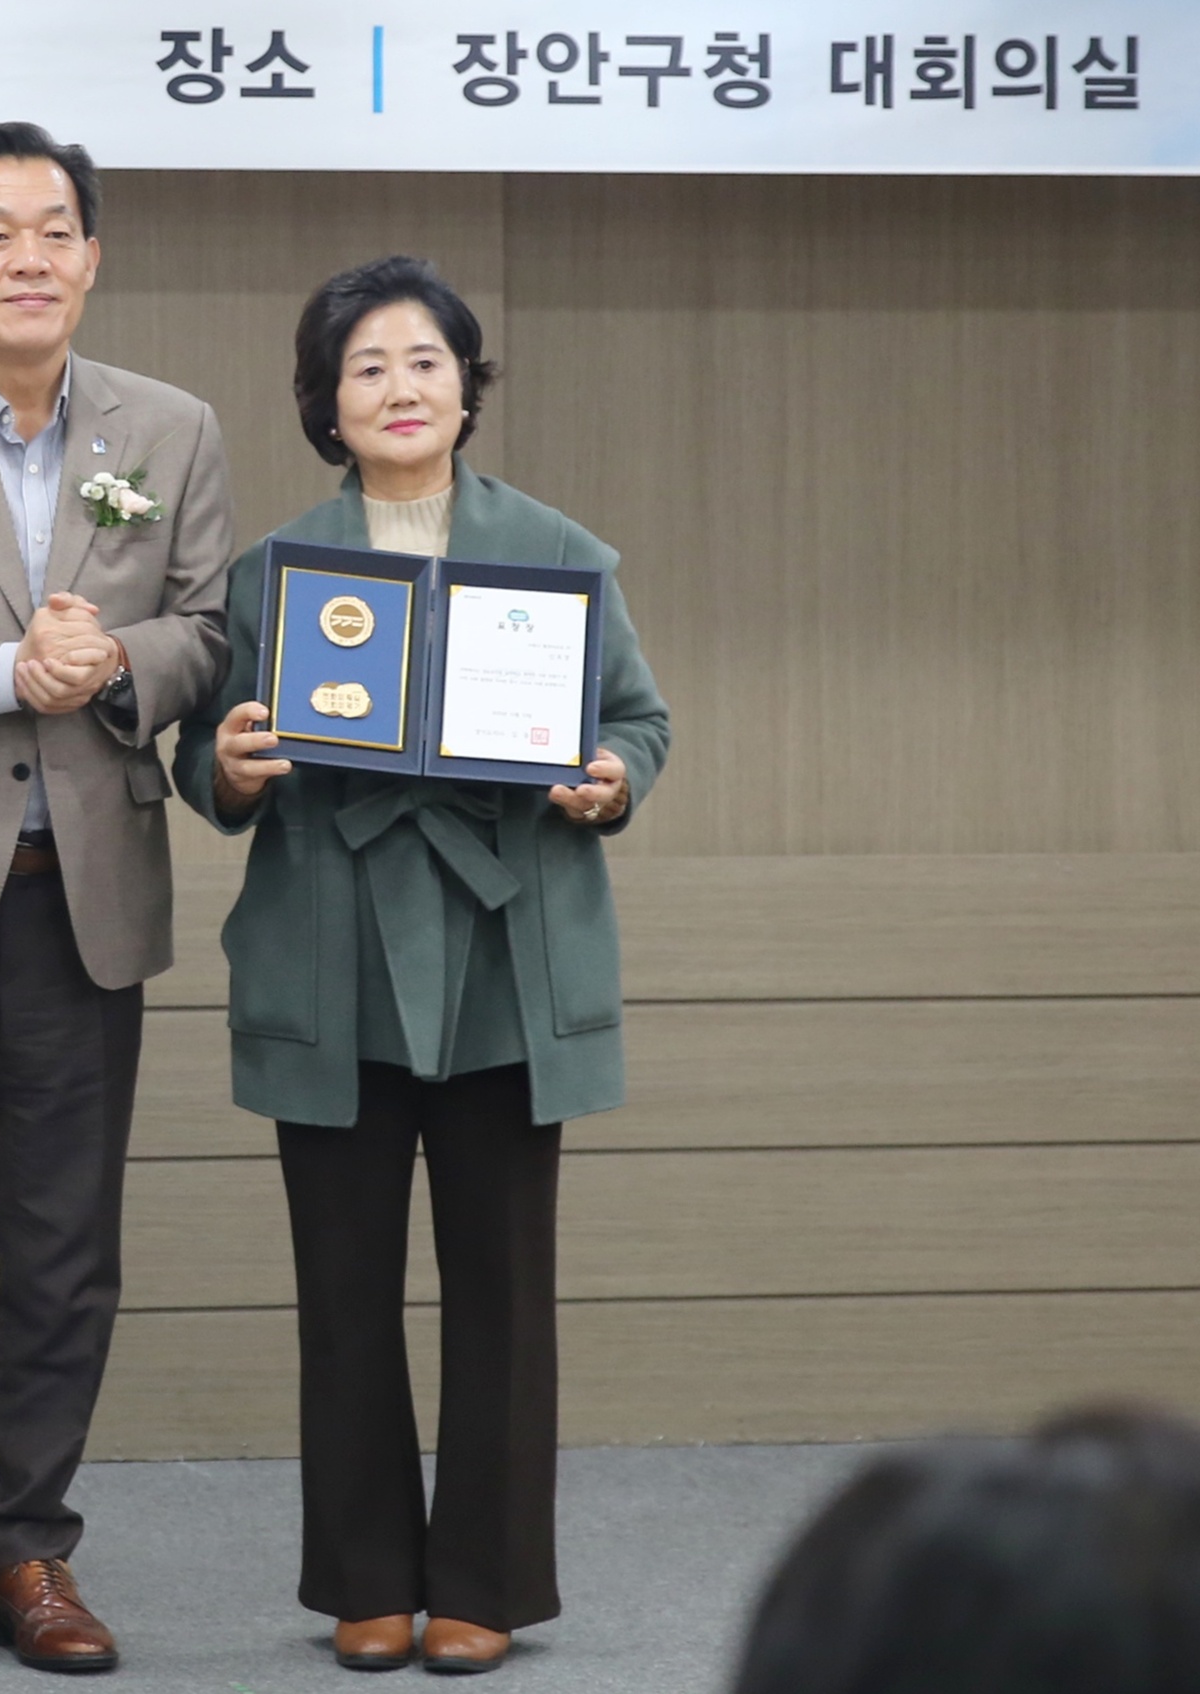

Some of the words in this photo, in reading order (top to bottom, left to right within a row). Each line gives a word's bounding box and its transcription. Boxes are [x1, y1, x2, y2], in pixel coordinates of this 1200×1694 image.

[155, 27, 315, 104] 장소
[451, 31, 771, 109] 장안구청
[829, 34, 1140, 110] 대회의실
